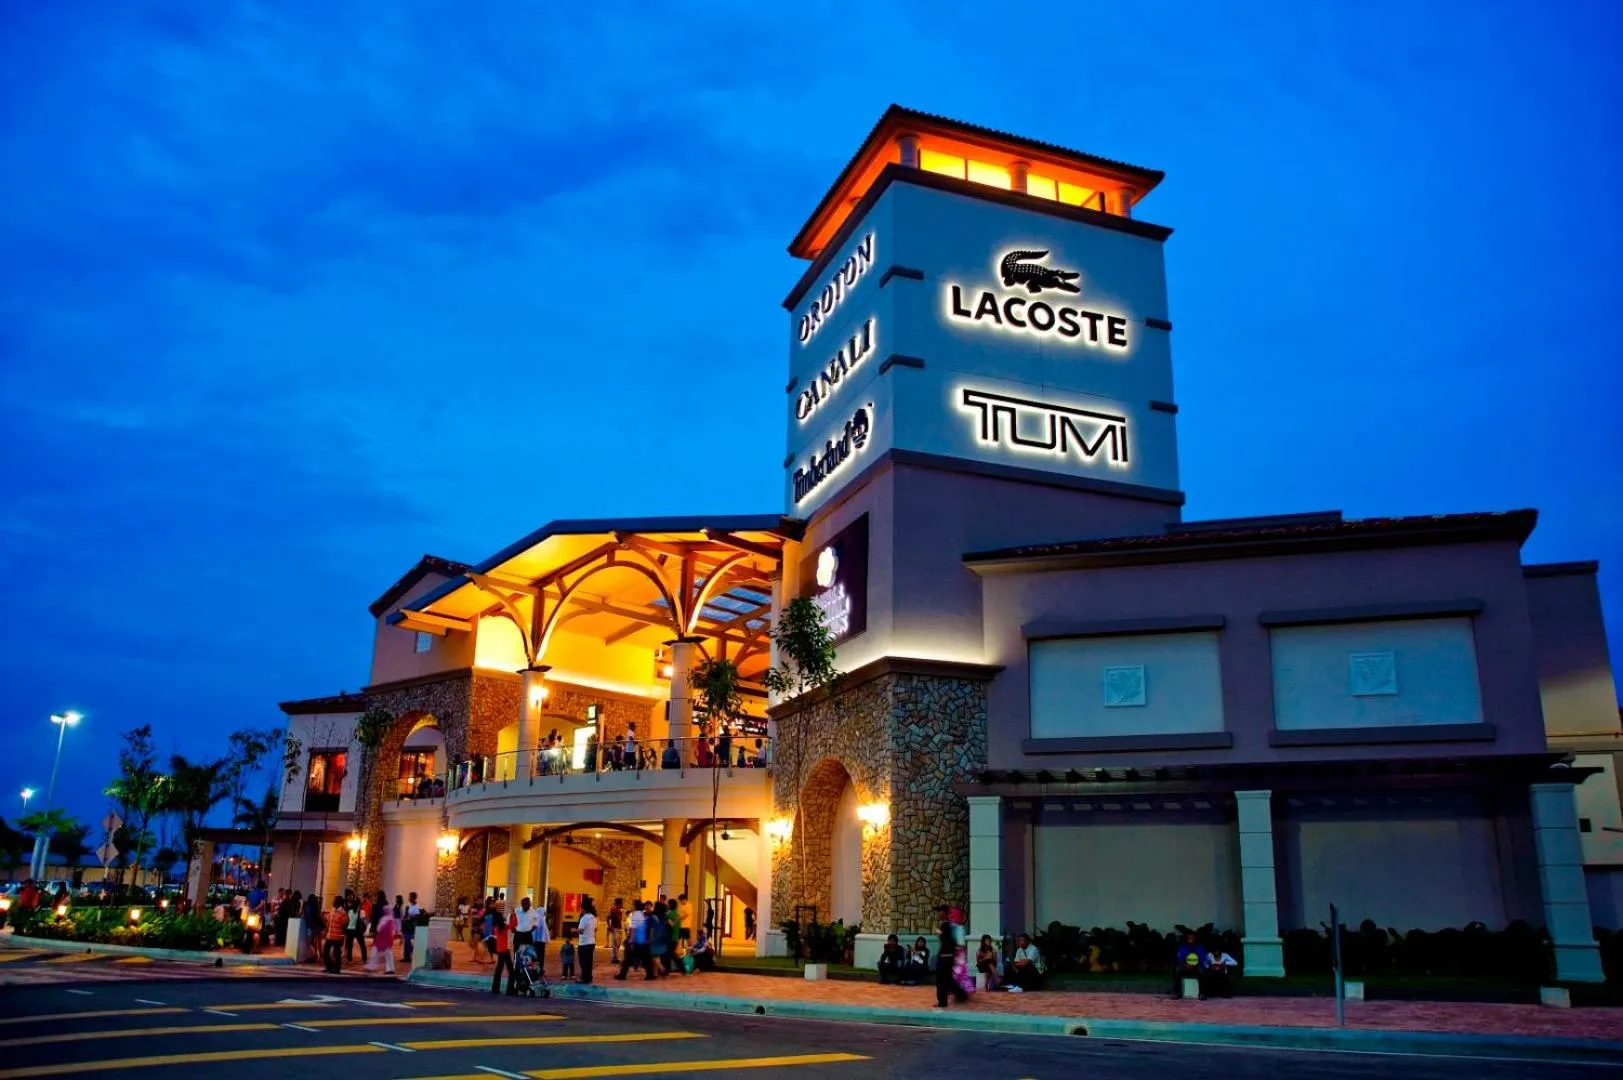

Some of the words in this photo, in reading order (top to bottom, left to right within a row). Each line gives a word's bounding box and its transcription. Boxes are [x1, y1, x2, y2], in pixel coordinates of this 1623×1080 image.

[799, 234, 872, 341] OROTON
[950, 285, 1128, 347] LACOSTE
[796, 319, 871, 419] CANALI
[793, 421, 852, 503] Timberland
[963, 388, 1129, 463] TUMI
